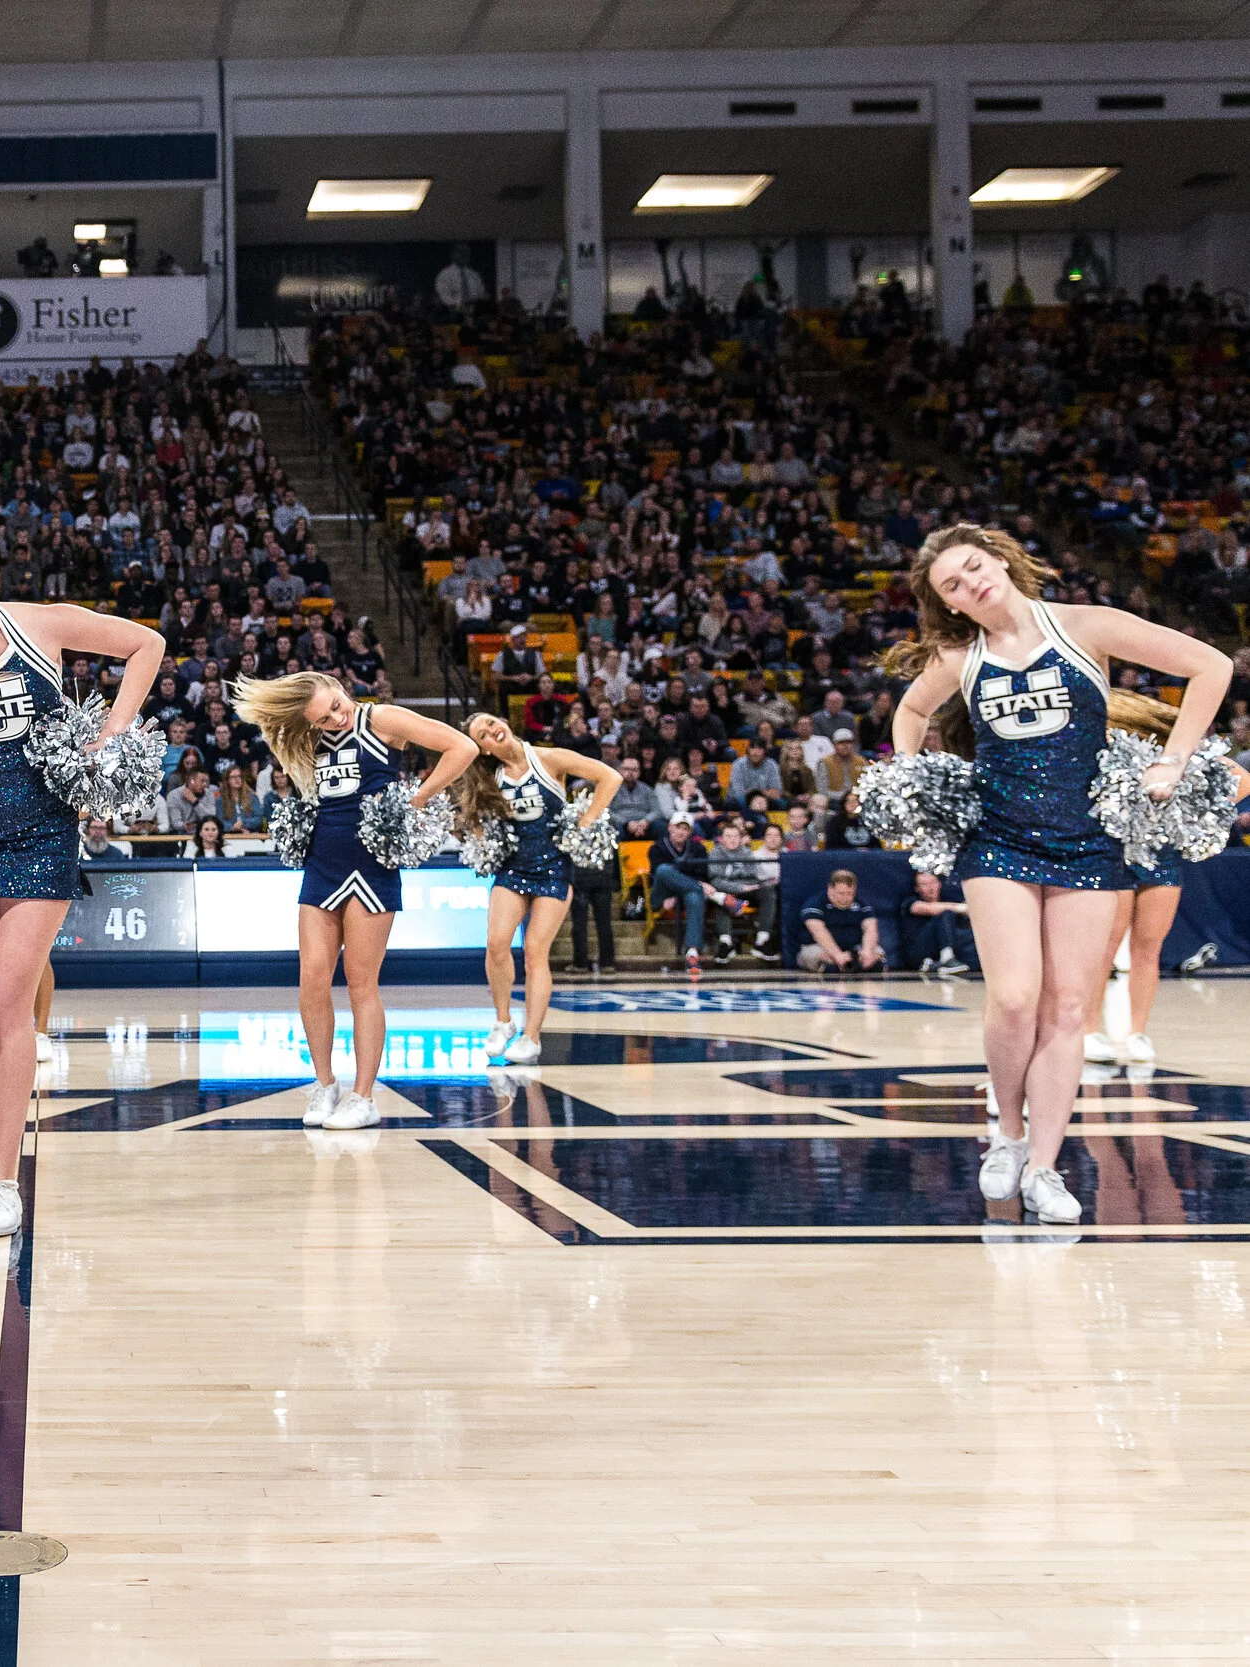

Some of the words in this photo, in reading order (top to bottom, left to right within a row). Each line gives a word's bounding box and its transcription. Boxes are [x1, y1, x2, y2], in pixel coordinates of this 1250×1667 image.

[578, 243, 595, 258] M
[32, 296, 137, 330] Fisher
[27, 331, 66, 344] Home
[69, 330, 143, 345] Furnishings
[978, 686, 1073, 722] STATE
[104, 907, 148, 941] 46
